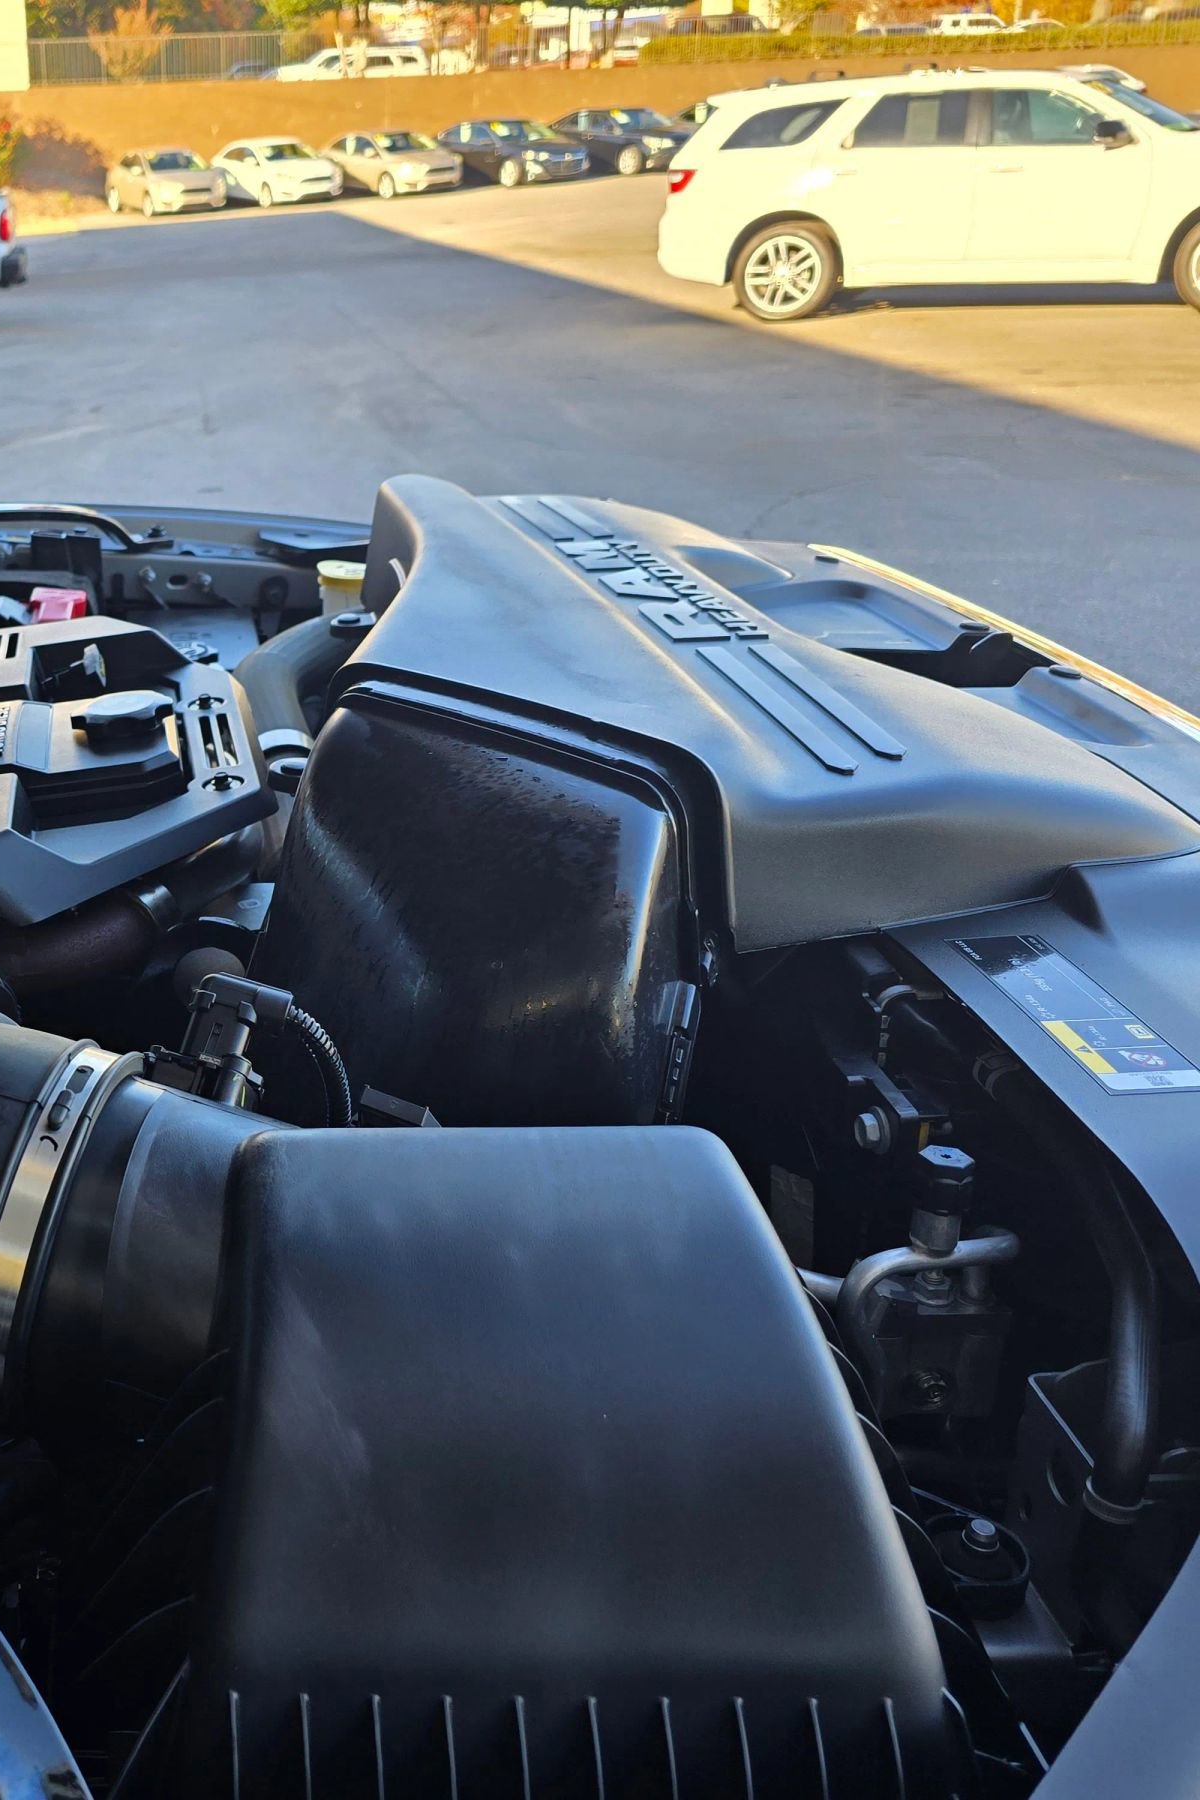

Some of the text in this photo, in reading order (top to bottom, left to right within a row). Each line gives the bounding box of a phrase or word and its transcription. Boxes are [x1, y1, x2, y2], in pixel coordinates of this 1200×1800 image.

[555, 540, 731, 641] RAM
[608, 540, 769, 640] HEAVY DUTY
